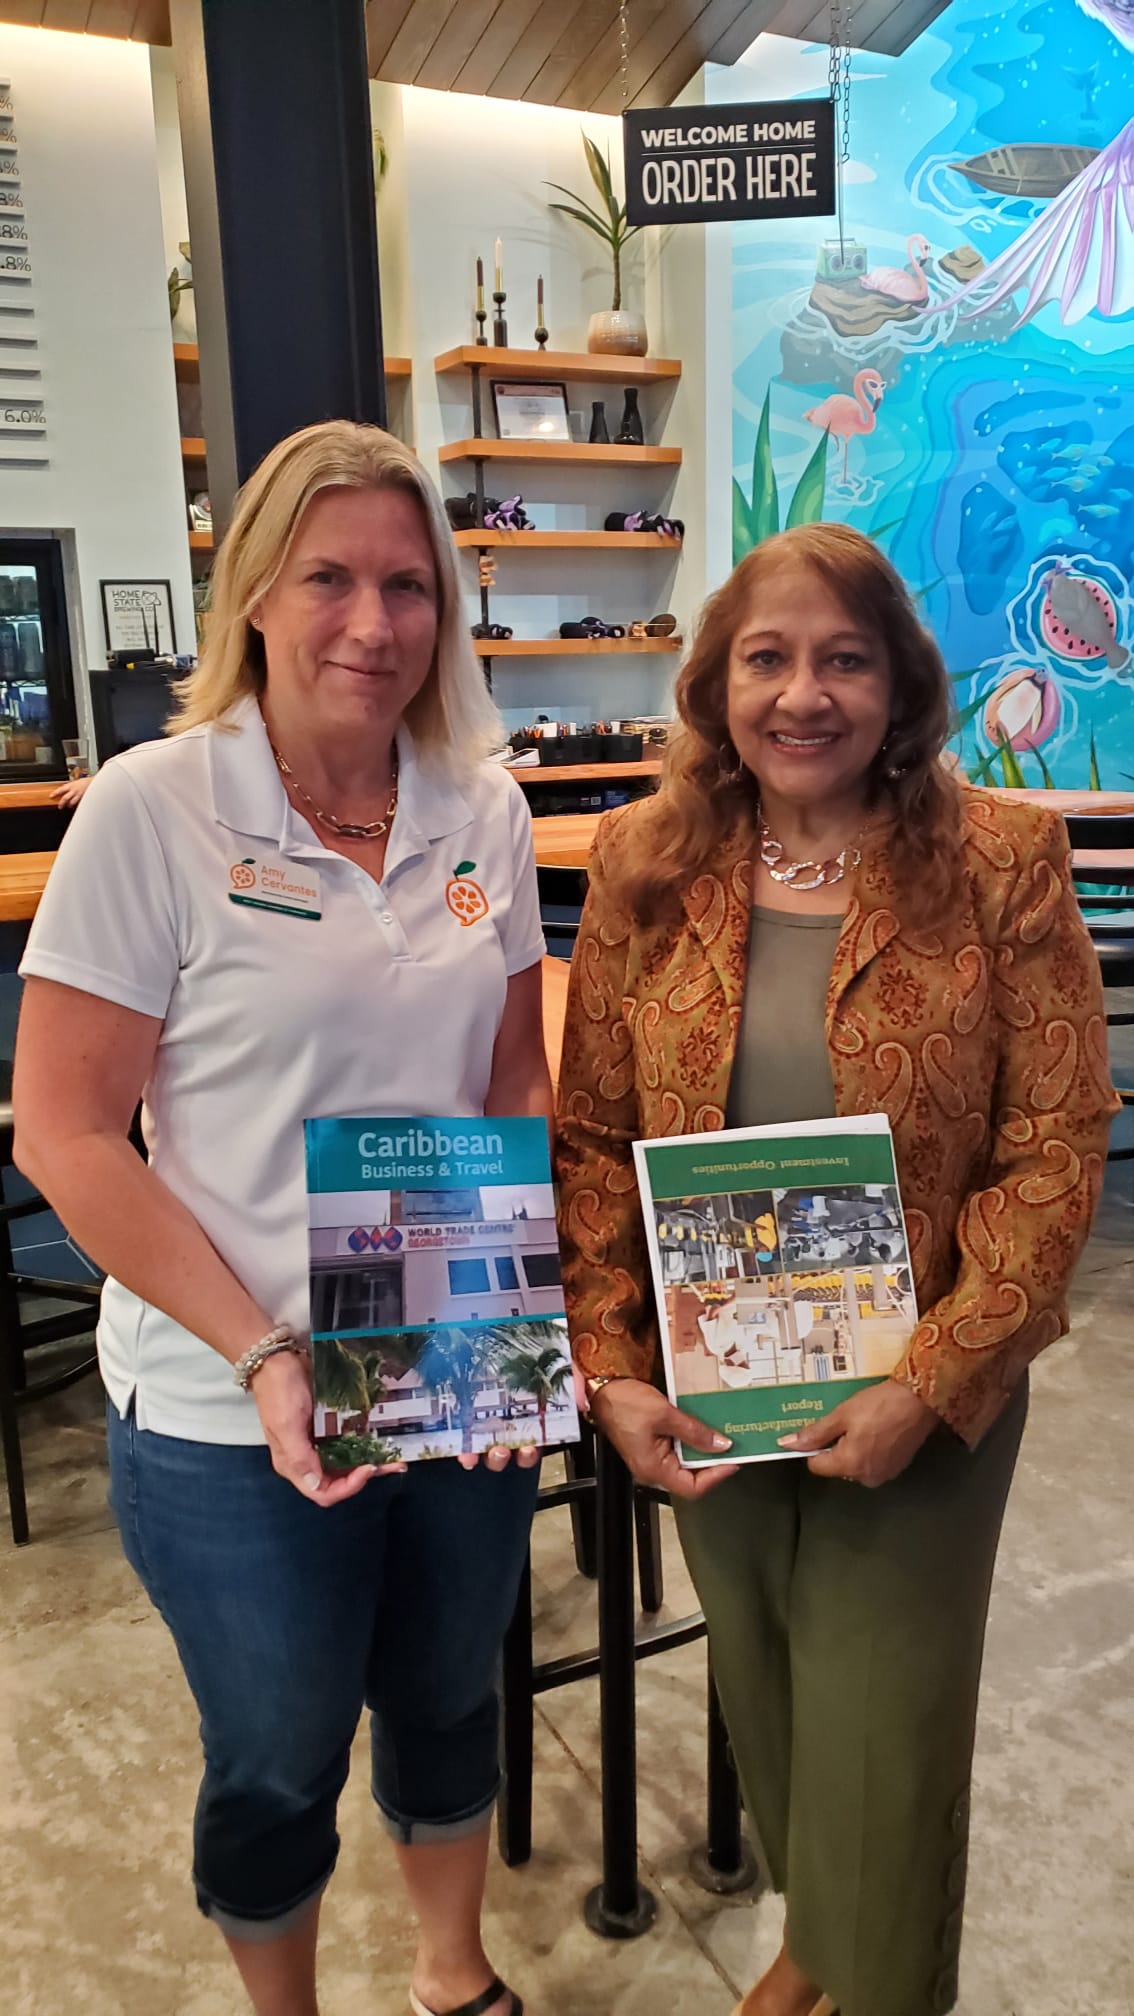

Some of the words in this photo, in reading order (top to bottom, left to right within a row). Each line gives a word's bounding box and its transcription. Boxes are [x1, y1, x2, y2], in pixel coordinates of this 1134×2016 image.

[641, 124, 748, 148] WELCOME
[753, 120, 816, 142] HOME
[642, 157, 737, 205] ORDER
[746, 152, 817, 200] HERE
[5, 409, 47, 423] 6.0%
[112, 590, 140, 598] HOME
[114, 598, 141, 606] STATE
[261, 865, 286, 880] Amy
[261, 877, 317, 897] Cervantes
[358, 1129, 503, 1158] Caribbean
[361, 1162, 434, 1179] Business
[438, 1162, 451, 1176] &
[454, 1160, 503, 1175] Travel
[692, 1160, 776, 1175] Opportunities
[780, 1157, 849, 1168] Investment
[408, 1227, 442, 1237] WORLD
[445, 1225, 475, 1235] TRADE
[782, 1399, 823, 1413] Report
